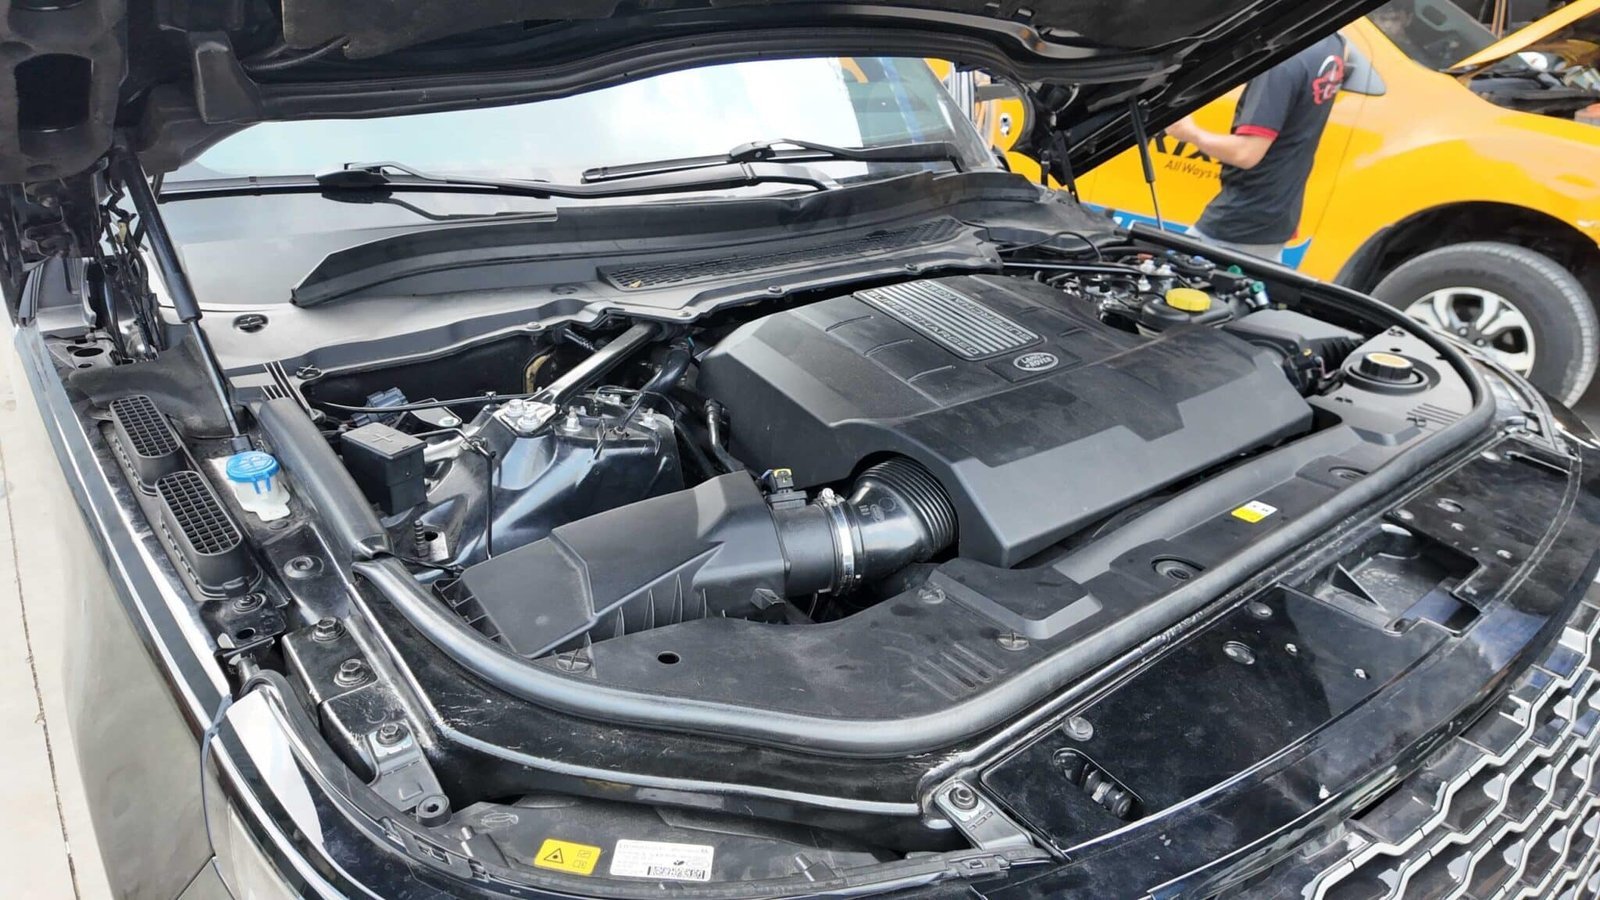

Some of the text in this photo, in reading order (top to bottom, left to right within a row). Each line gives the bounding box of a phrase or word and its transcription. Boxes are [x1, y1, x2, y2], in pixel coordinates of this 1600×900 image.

[1164, 160, 1182, 172] All
[1182, 162, 1213, 179] Ways
[918, 280, 1033, 341] SUPERCHARGED
[865, 289, 980, 355] SUPERCHARGED
[1021, 353, 1044, 364] LAND
[1029, 356, 1053, 368] ROVER
